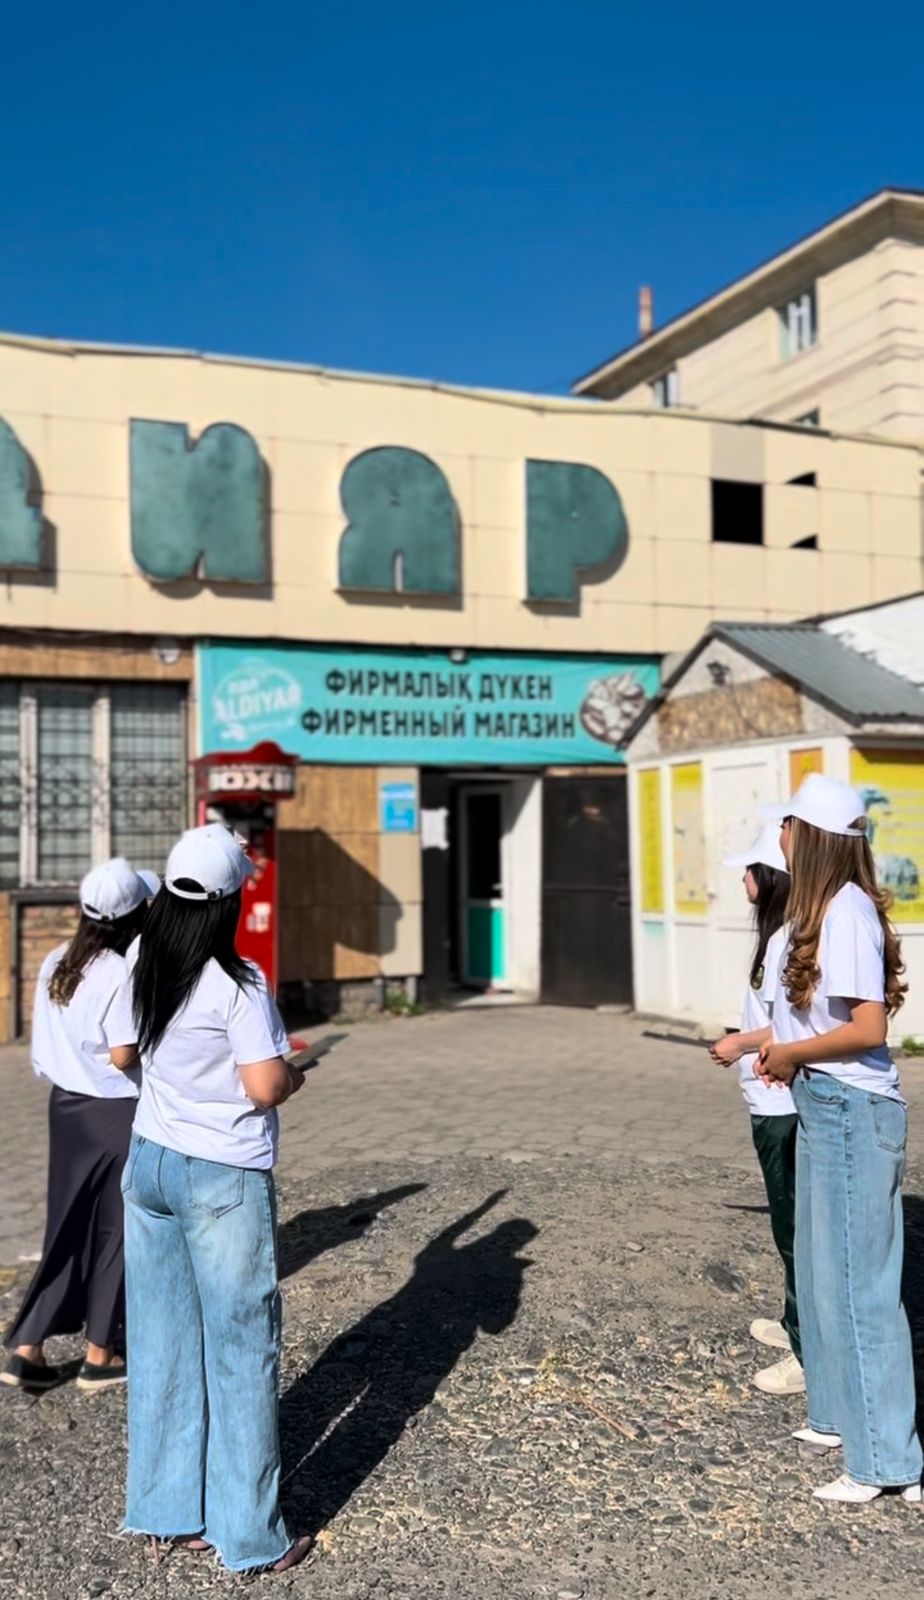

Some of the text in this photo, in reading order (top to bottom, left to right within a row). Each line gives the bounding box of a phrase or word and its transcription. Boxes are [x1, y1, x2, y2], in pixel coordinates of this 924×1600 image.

[325, 669, 552, 702] ФИРМАЛЫҚ ДҮКЕН
[301, 705, 576, 739] ФИРМЕННЫЙ МАГАЗИН
